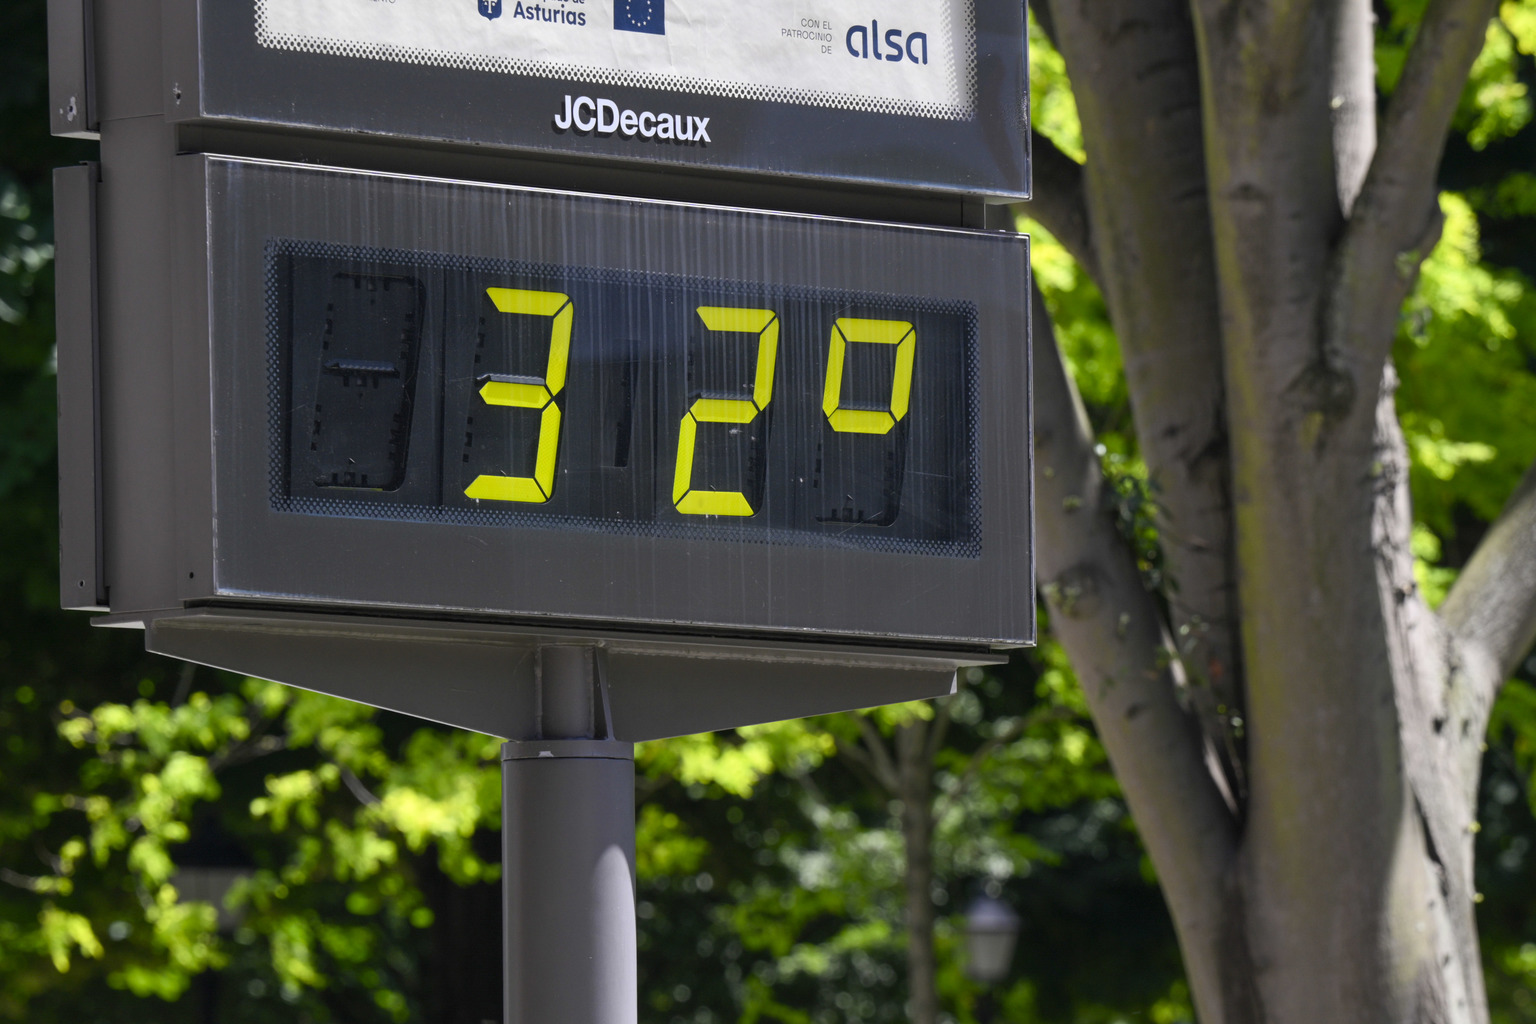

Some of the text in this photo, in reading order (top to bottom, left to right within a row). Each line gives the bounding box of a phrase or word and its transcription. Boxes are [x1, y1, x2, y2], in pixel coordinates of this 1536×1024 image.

[513, 1, 586, 26] Asturias
[800, 18, 832, 30] CON EL
[781, 28, 832, 42] PATROCINIO
[846, 19, 928, 65] alsa
[821, 45, 832, 54] DE
[554, 94, 712, 143] JCDecaux
